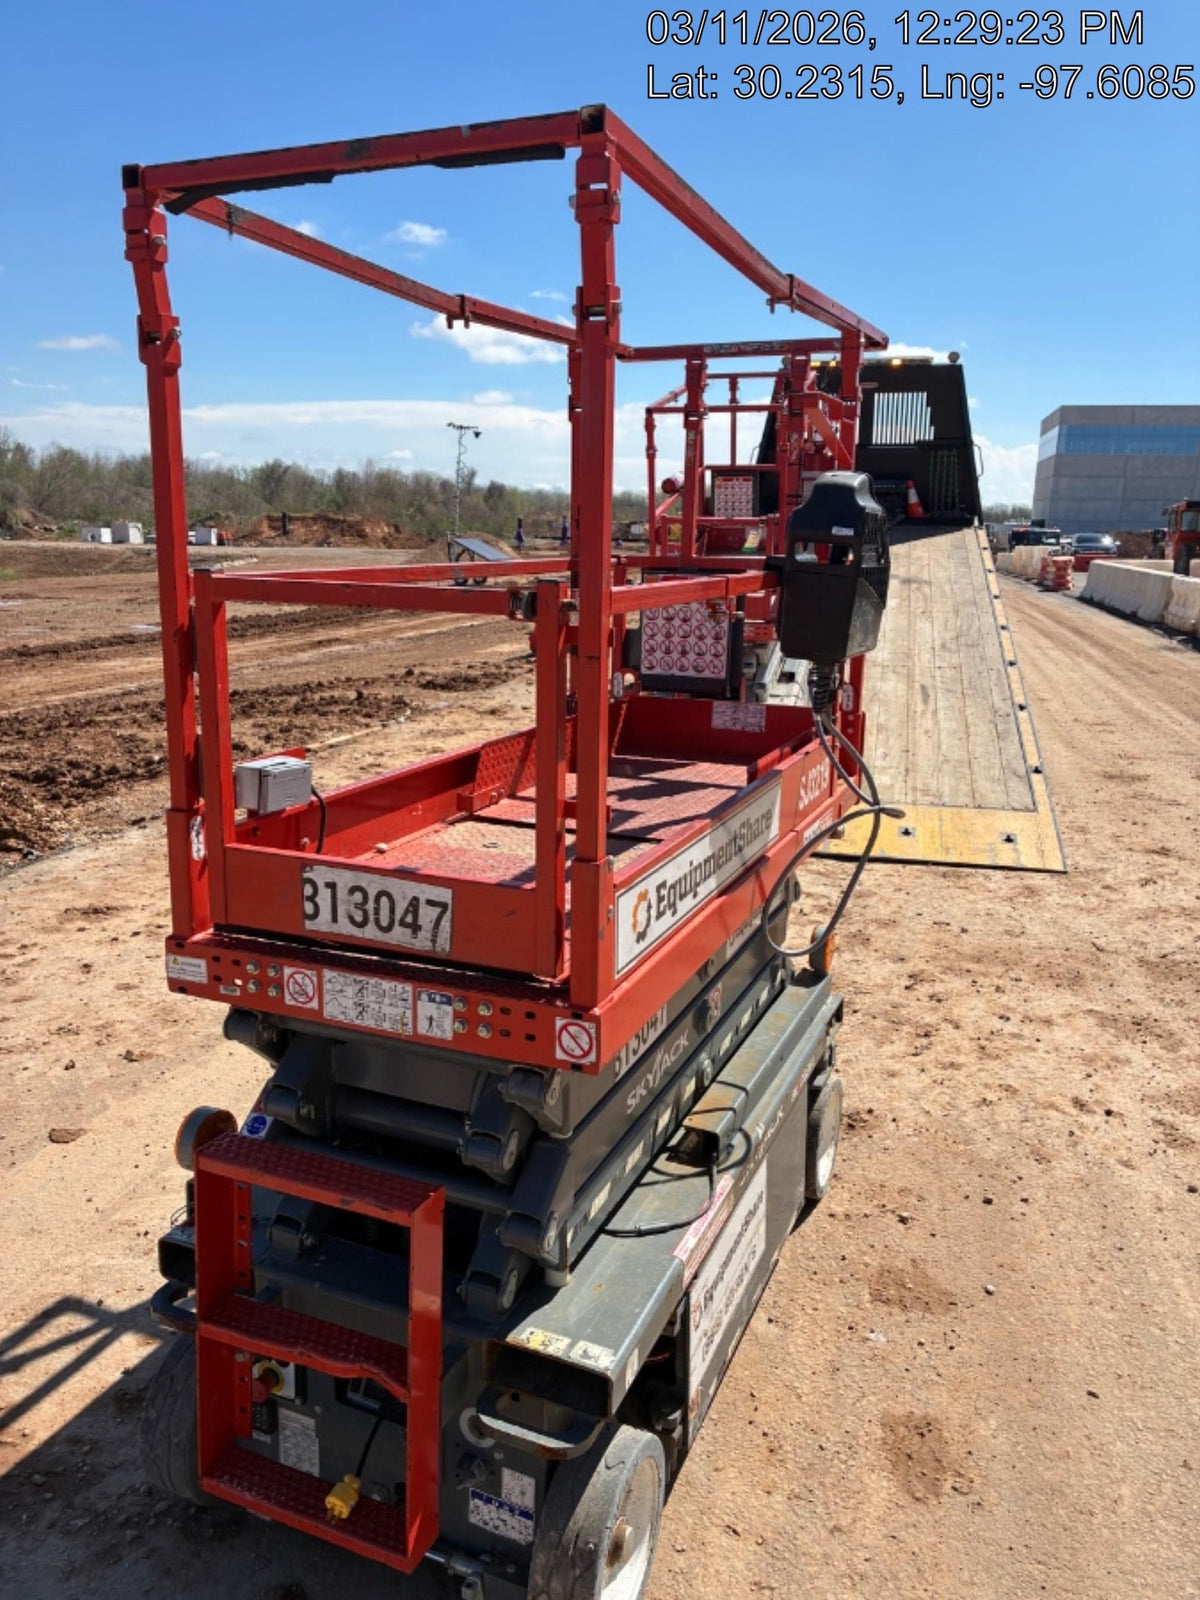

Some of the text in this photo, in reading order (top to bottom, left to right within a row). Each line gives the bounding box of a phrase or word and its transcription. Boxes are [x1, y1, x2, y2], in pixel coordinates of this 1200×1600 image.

[654, 807, 773, 922] EquipmentShare
[302, 876, 449, 949] 313047
[625, 1028, 690, 1115] SKYJACK
